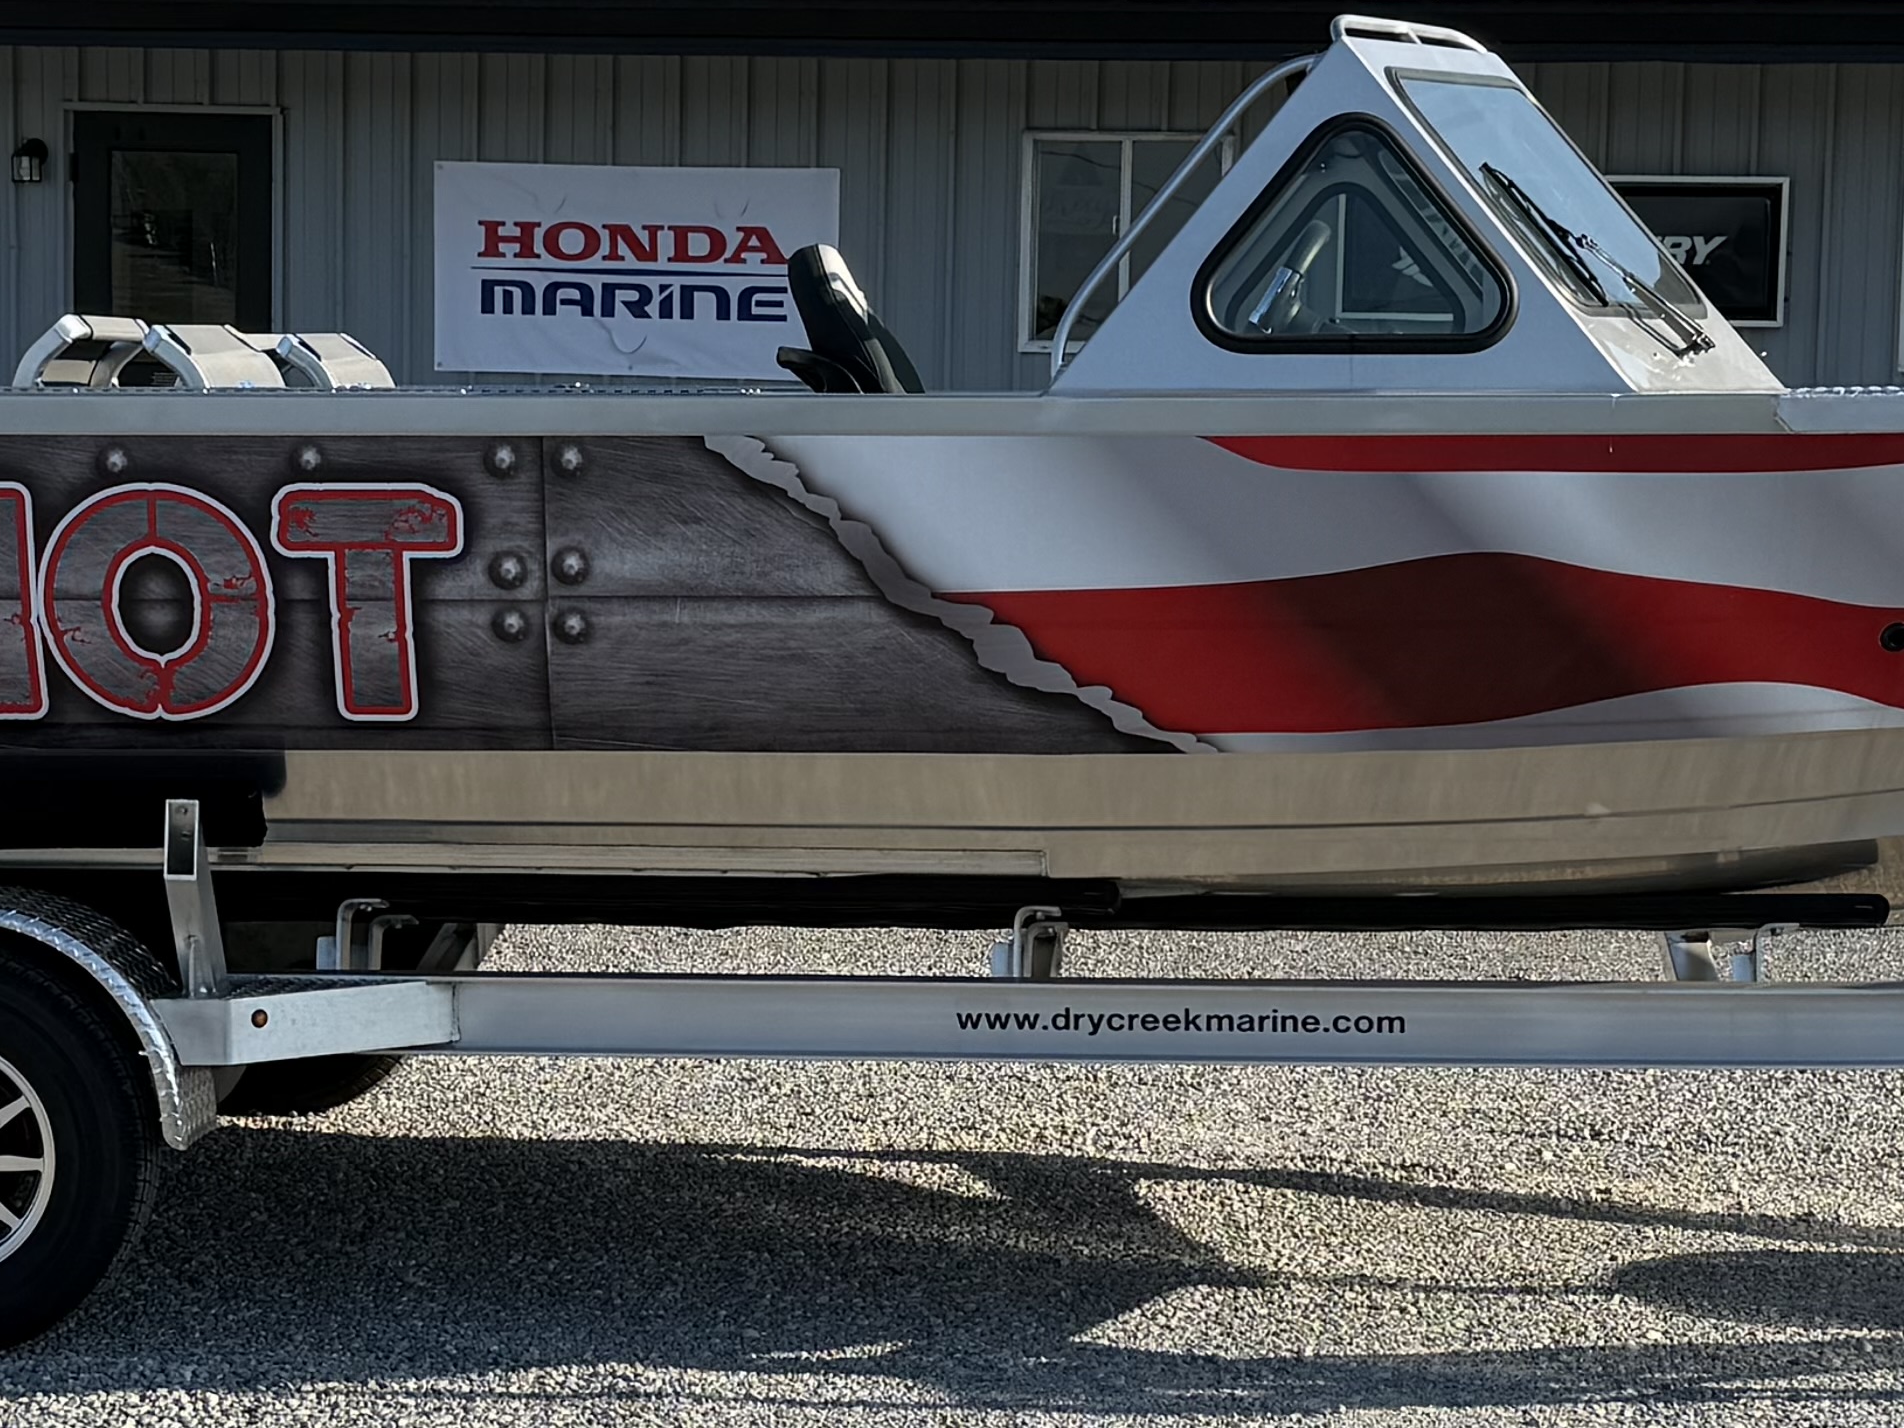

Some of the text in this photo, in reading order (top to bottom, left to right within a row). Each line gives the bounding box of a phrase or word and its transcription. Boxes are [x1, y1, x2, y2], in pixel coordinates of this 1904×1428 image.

[476, 219, 788, 265] HONDA
[480, 278, 788, 322] MARINE
[956, 1007, 1406, 1036] www.drycreekmarine.com
